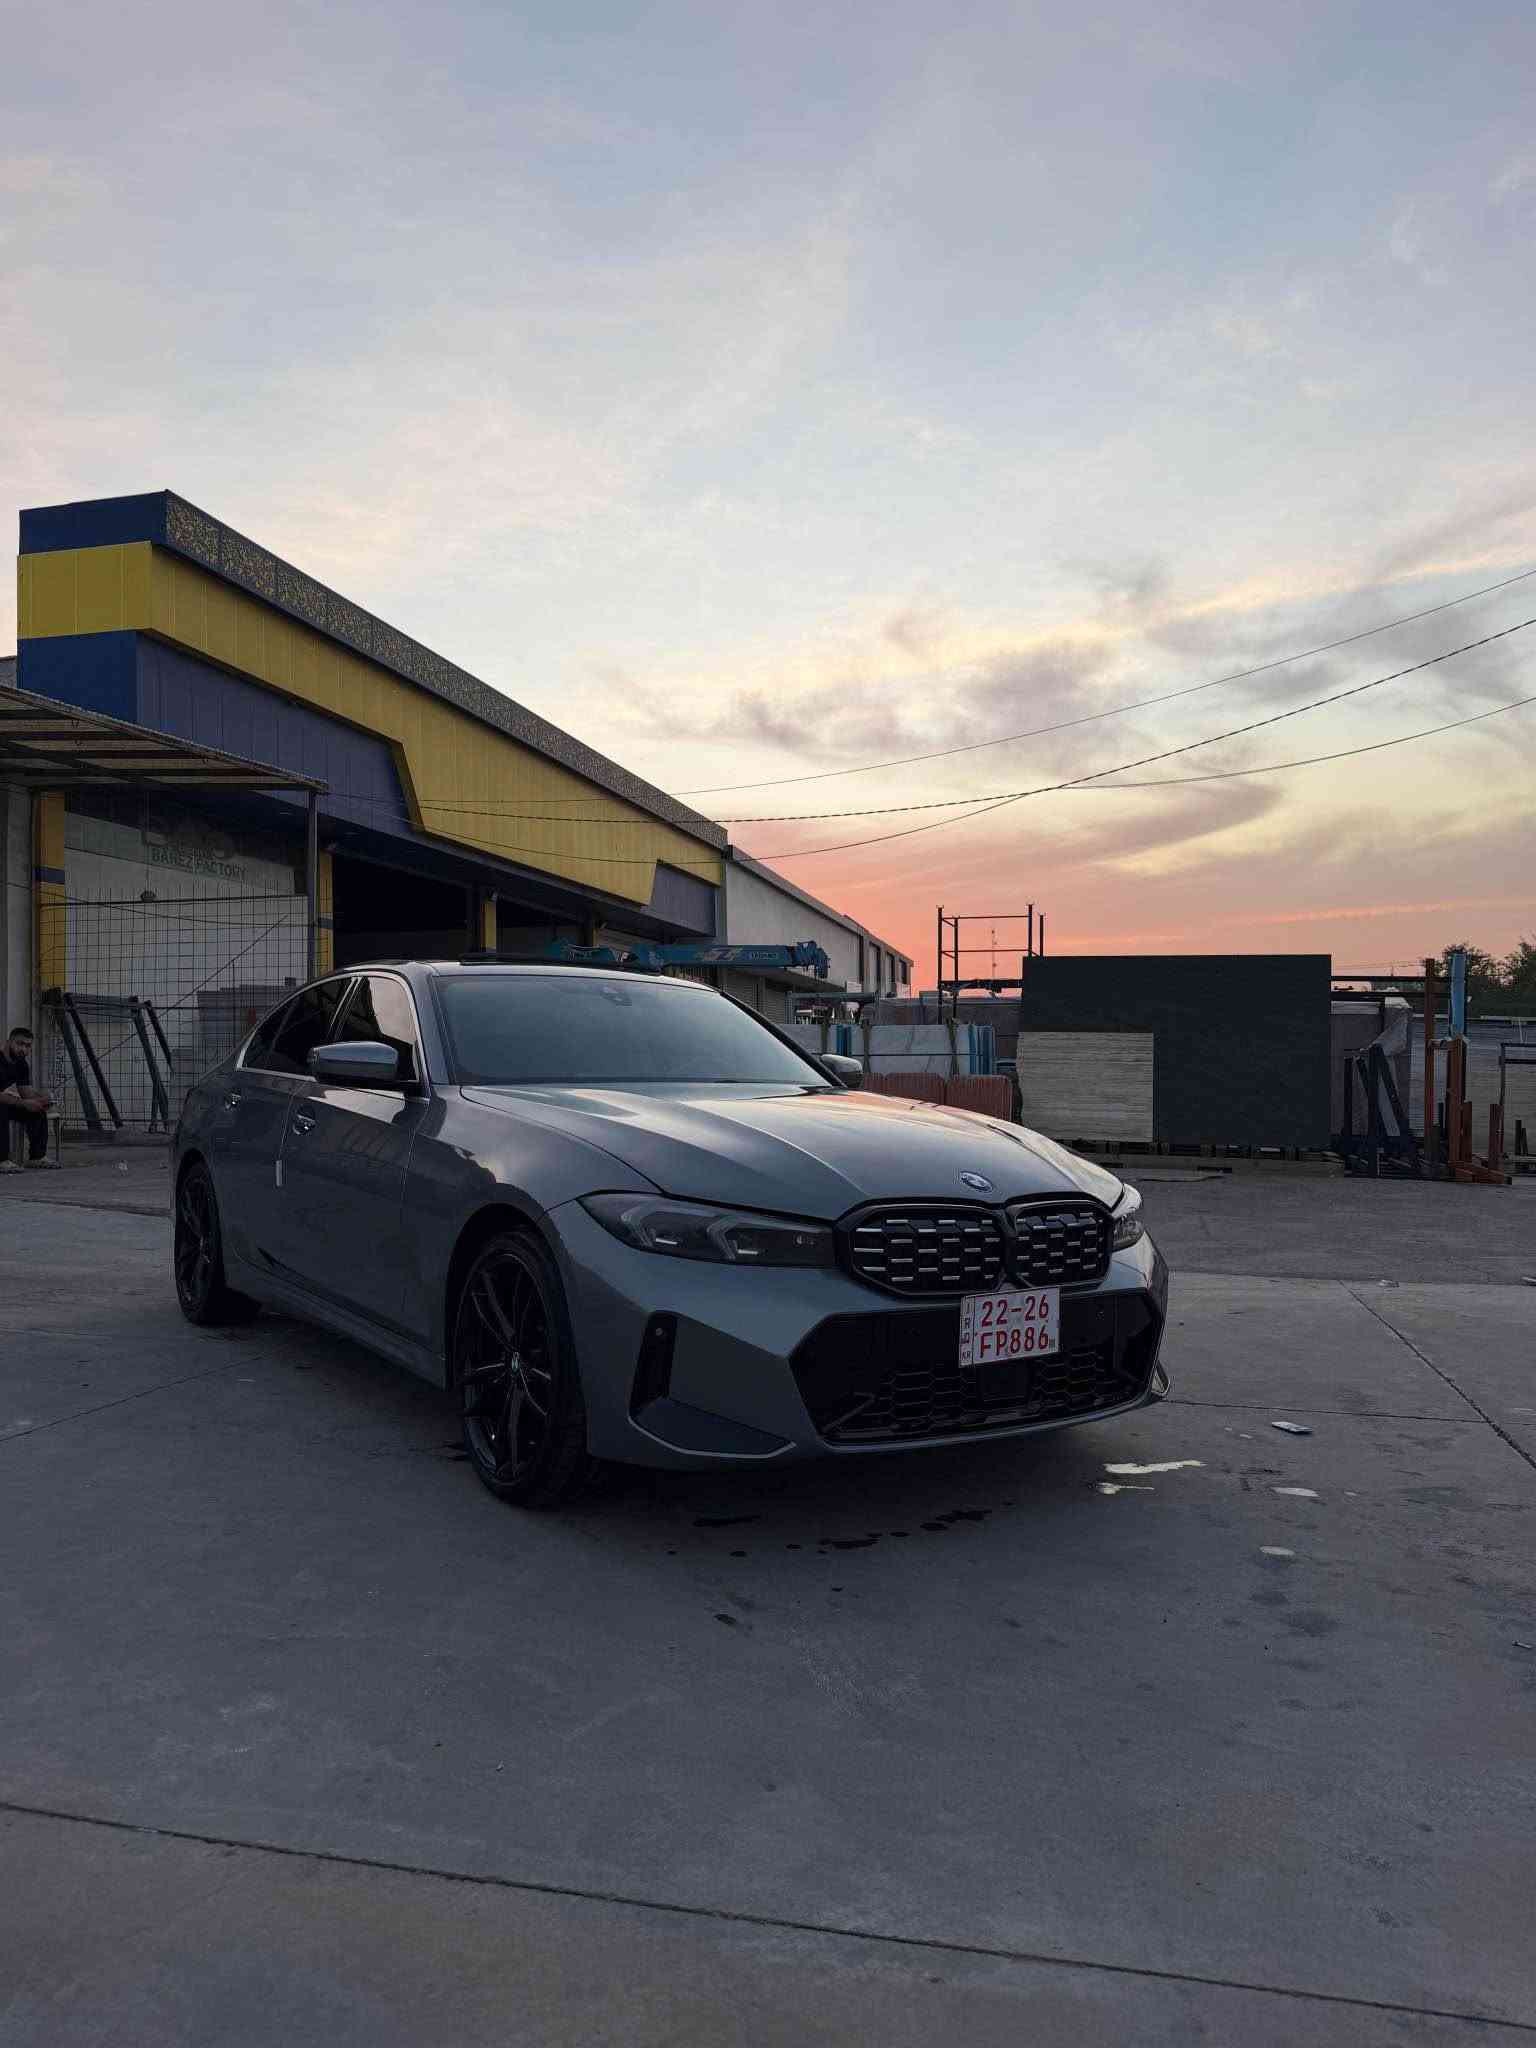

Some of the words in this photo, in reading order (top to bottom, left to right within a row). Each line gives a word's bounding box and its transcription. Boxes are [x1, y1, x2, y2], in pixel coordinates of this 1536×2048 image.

[194, 854, 248, 877] FACTORY
[982, 1294, 1049, 1327] 22-26
[980, 1325, 1049, 1358] FP886
